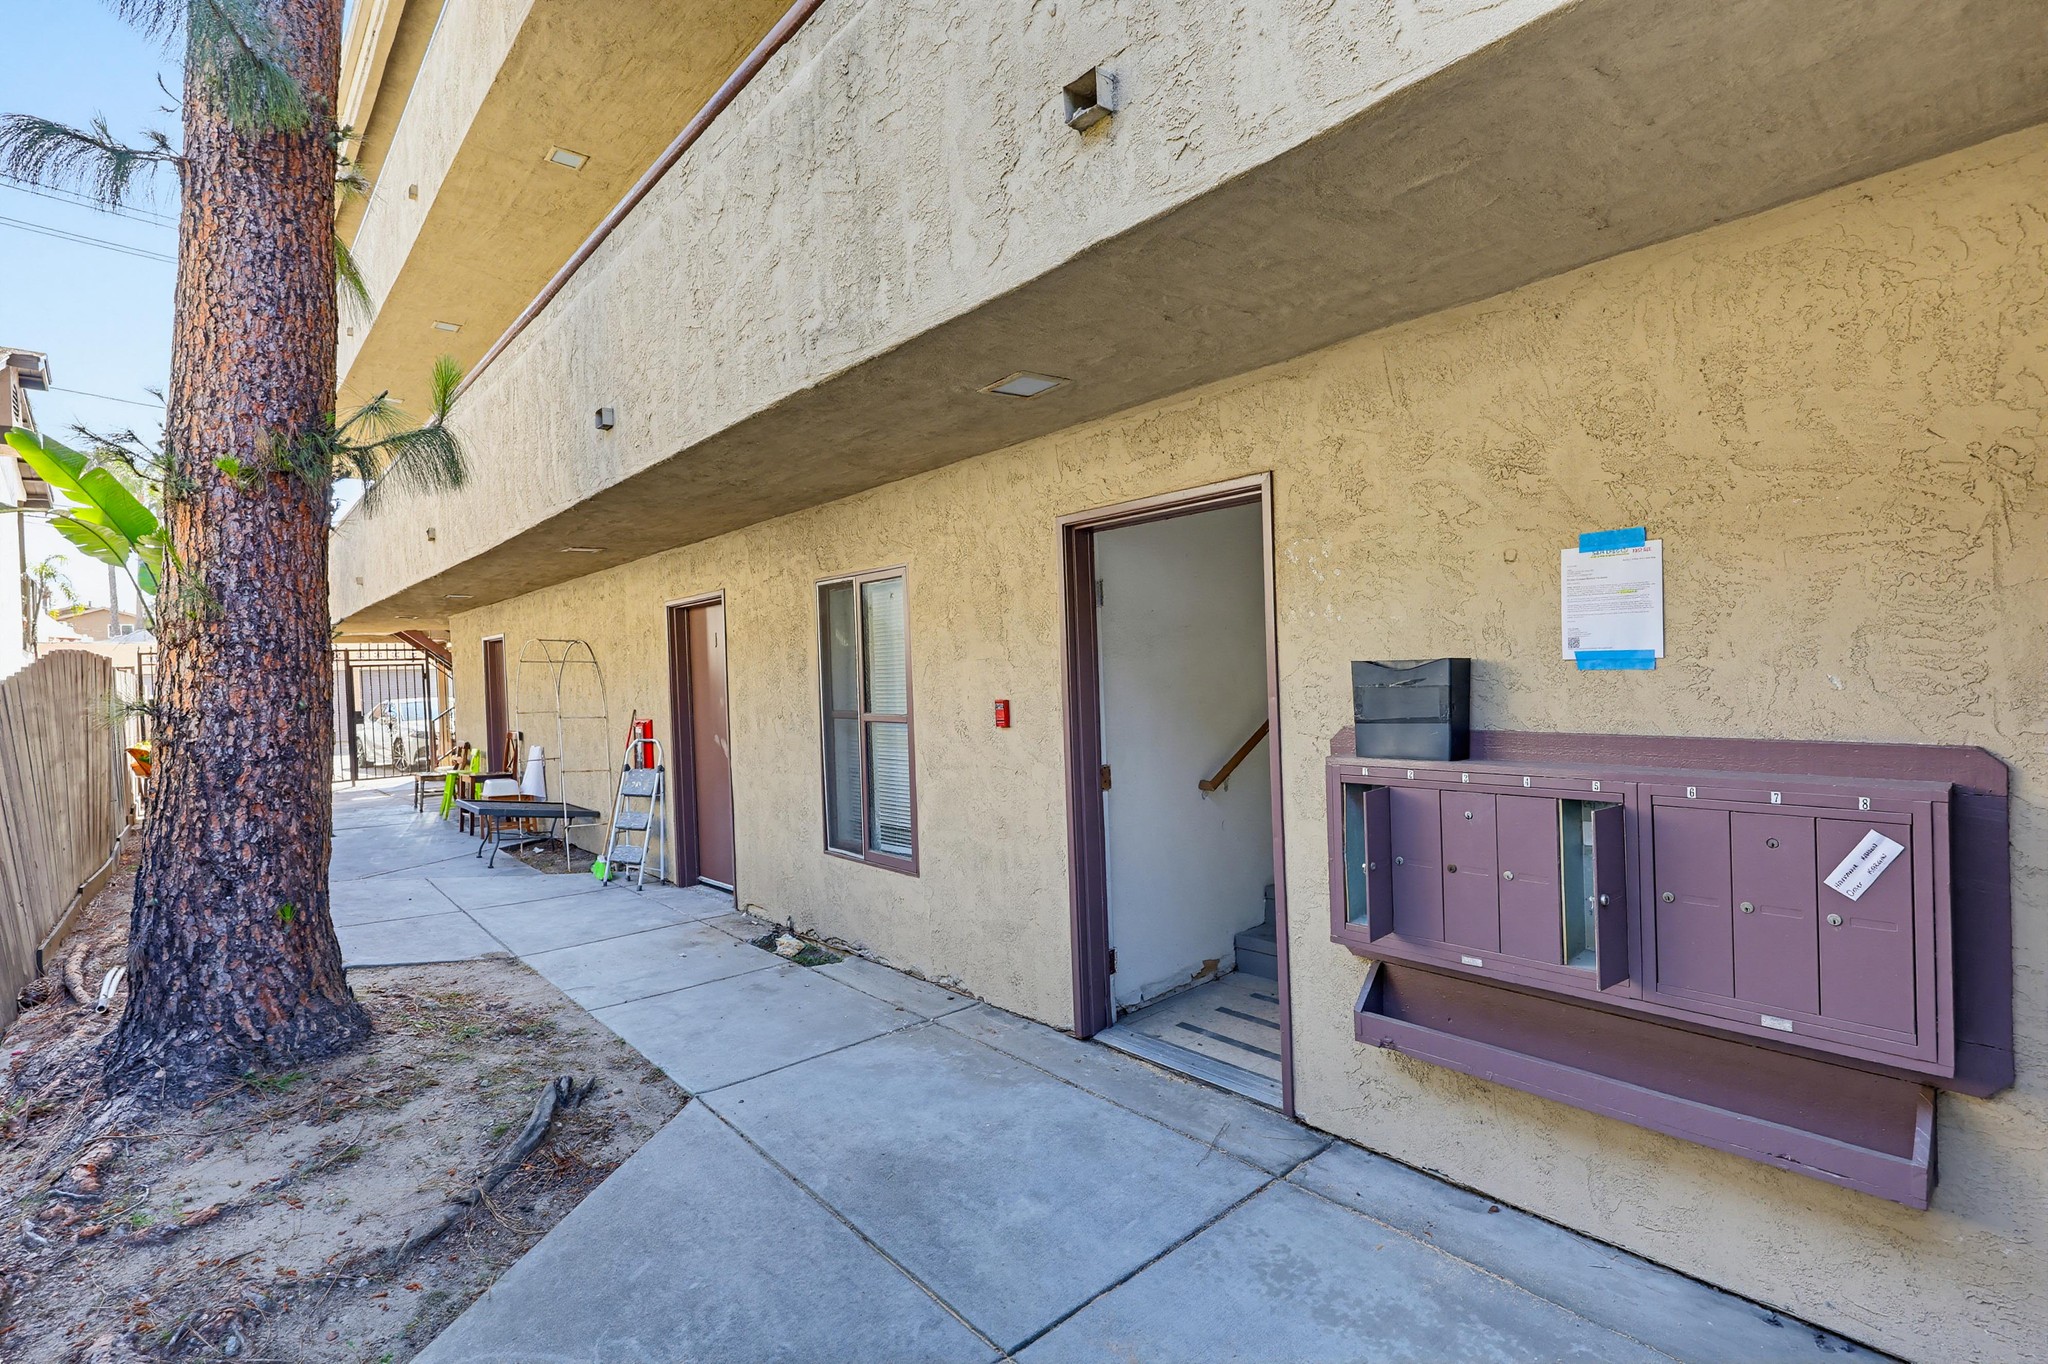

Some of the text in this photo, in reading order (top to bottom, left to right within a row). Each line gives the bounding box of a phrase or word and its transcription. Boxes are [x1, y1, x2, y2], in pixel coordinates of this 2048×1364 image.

[1689, 787, 1695, 797] 6
[1773, 793, 1779, 803] 7
[1862, 798, 1868, 810] 8
